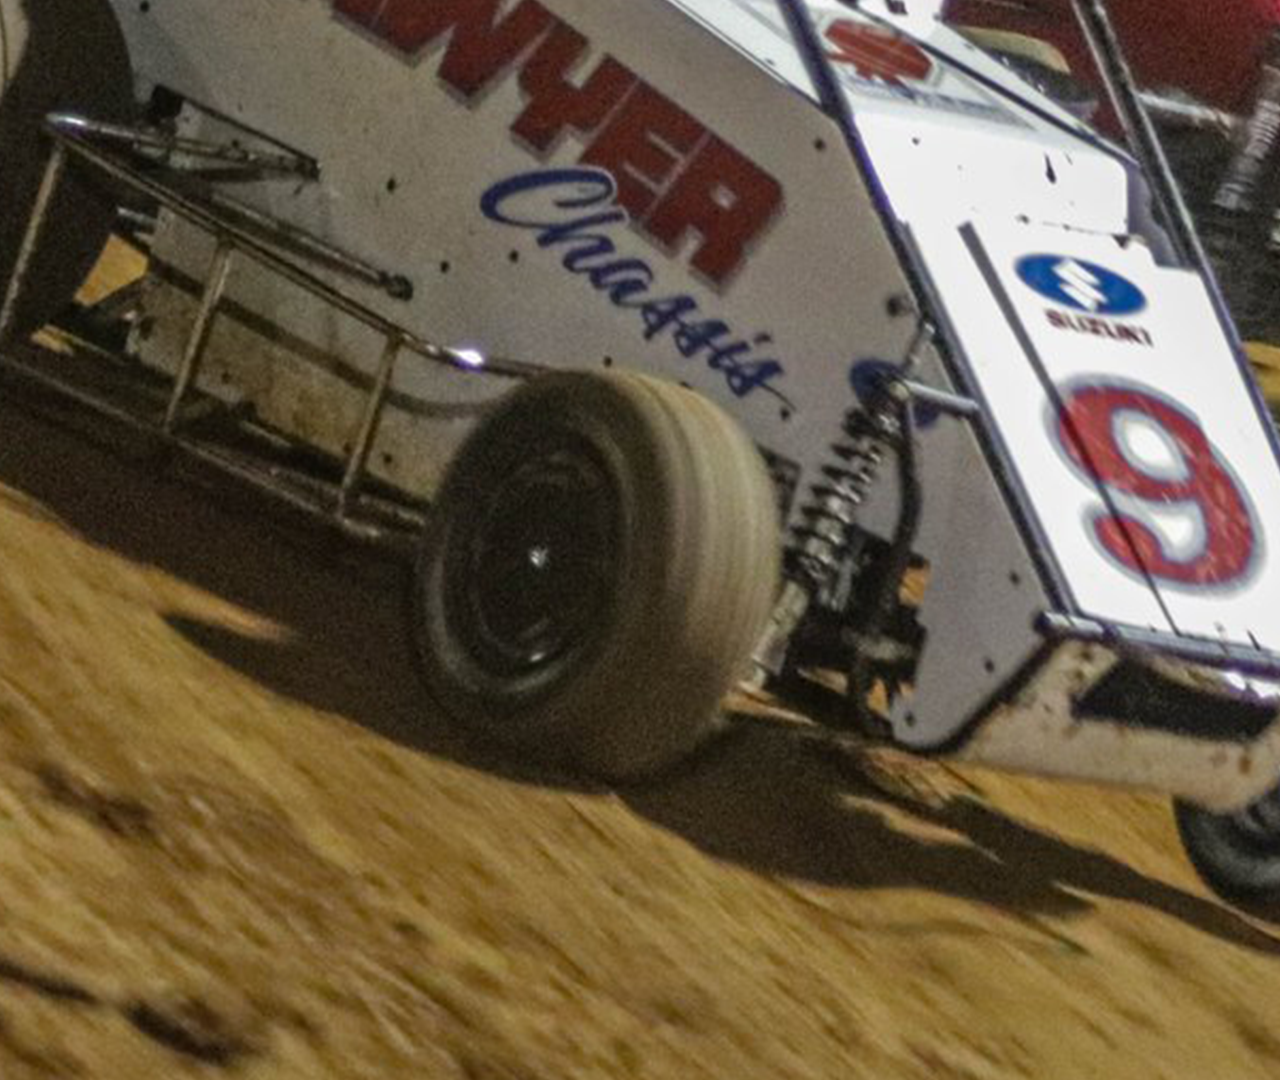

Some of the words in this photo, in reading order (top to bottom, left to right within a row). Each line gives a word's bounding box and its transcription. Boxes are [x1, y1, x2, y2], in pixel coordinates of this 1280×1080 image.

[480, 167, 796, 411] Chassis
[1044, 308, 1155, 348] SUZUKI
[1042, 372, 1267, 599] 9
